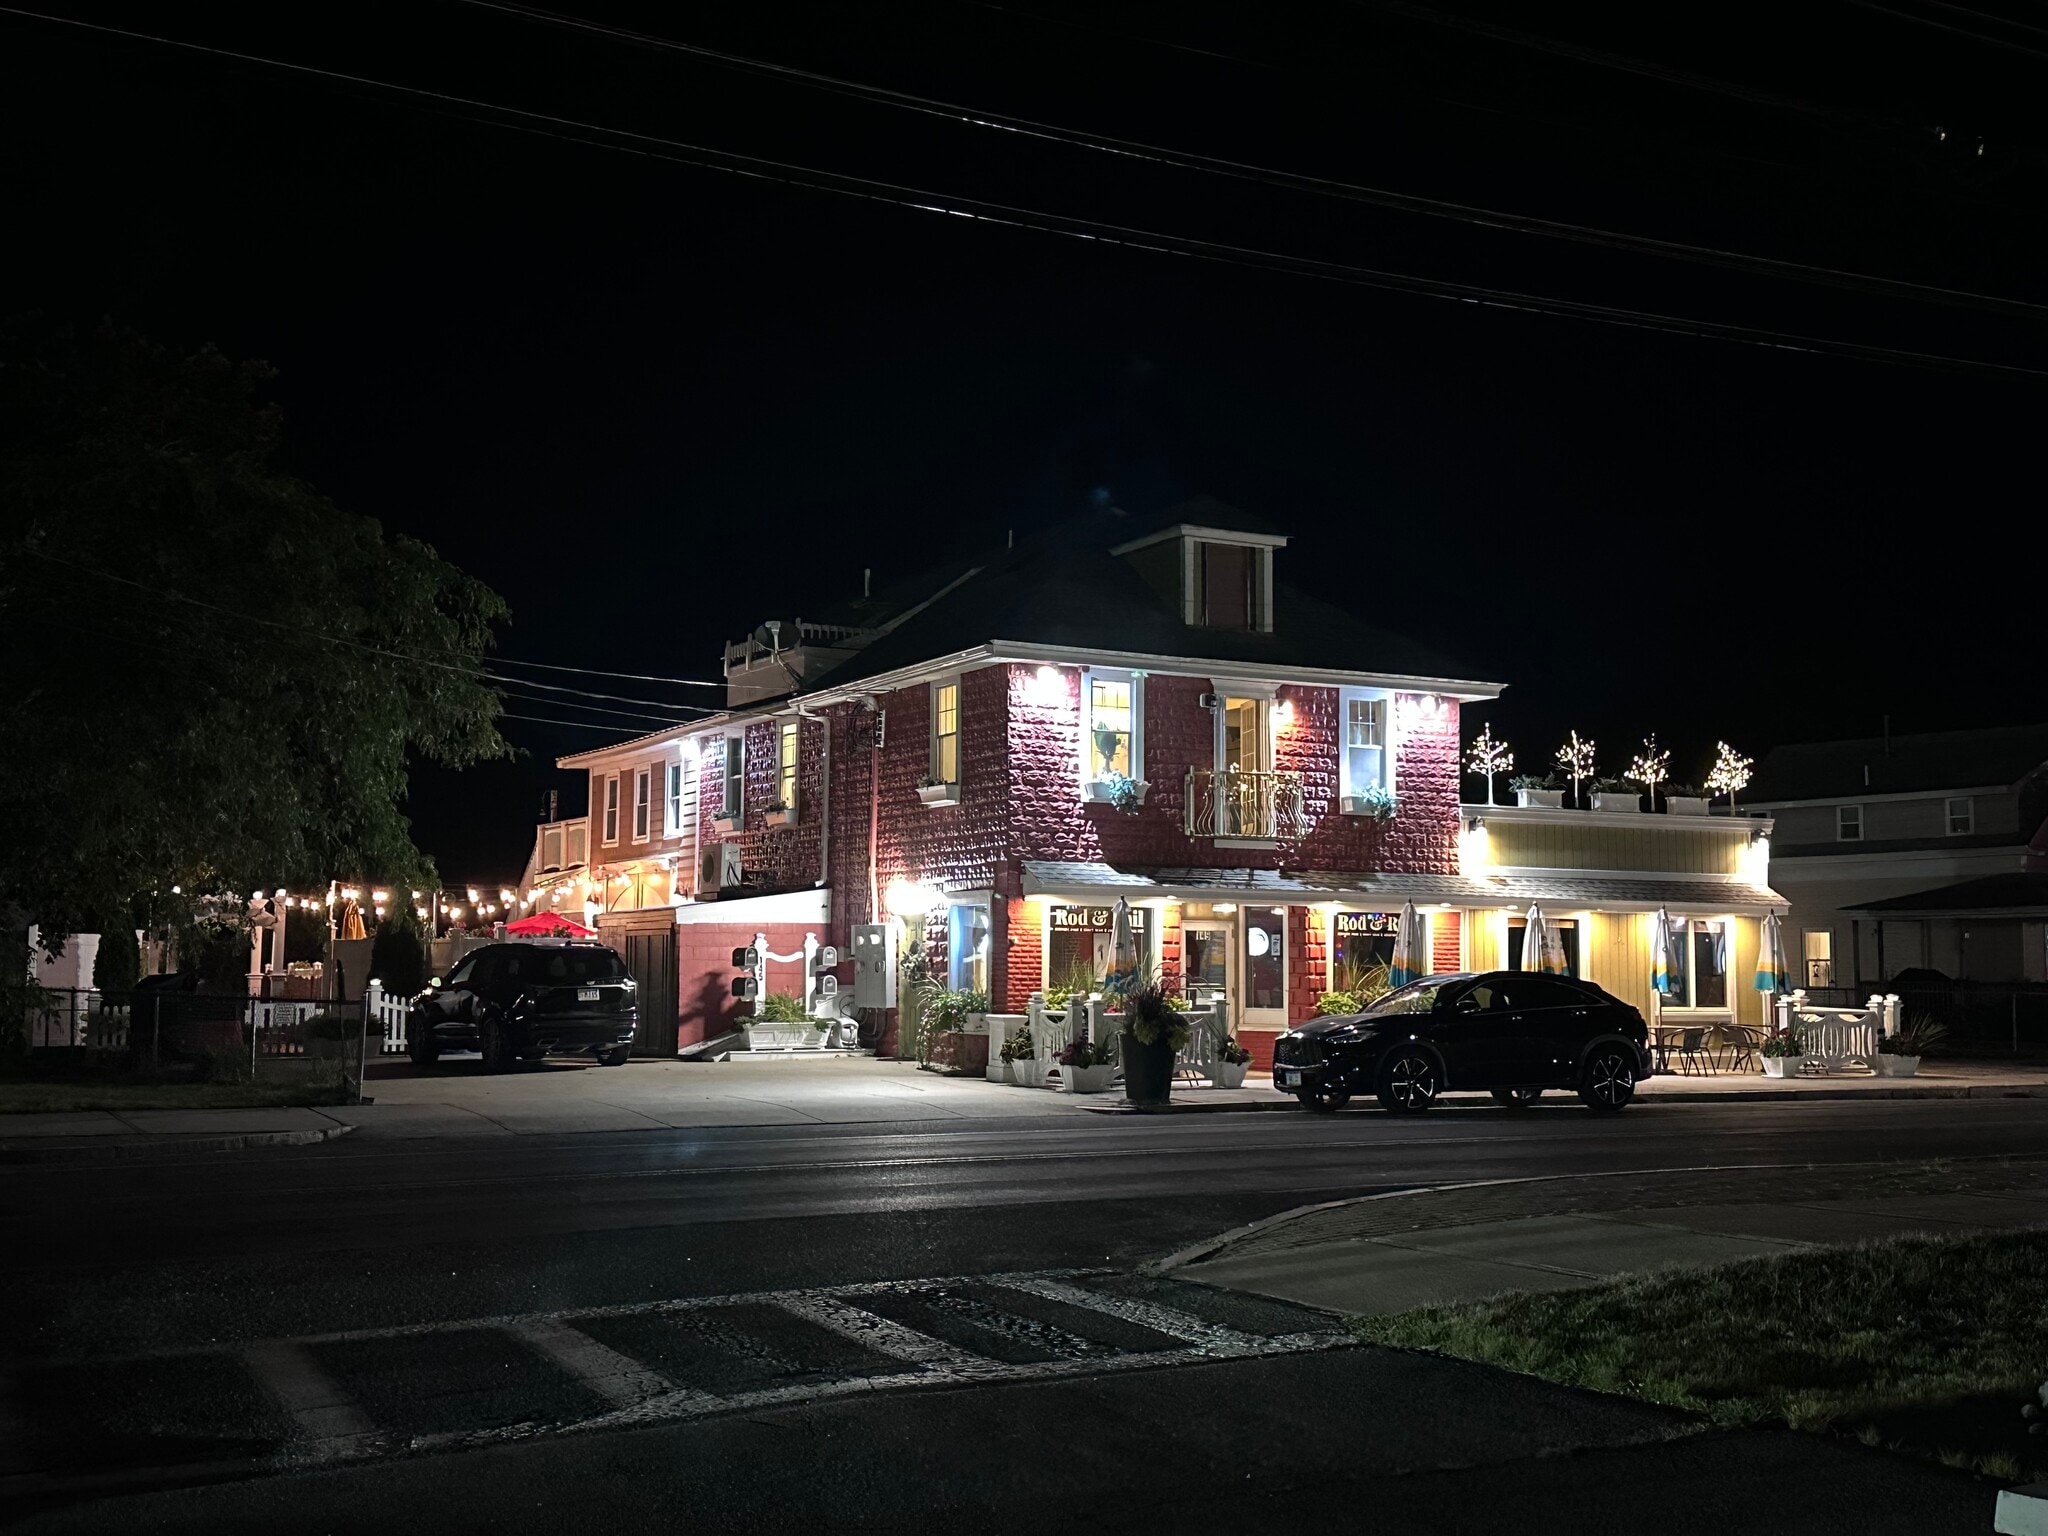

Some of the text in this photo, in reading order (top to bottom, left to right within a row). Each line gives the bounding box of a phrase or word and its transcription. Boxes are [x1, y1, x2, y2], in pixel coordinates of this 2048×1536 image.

[1055, 908, 1088, 926] Rod
[1091, 910, 1109, 926] &
[1337, 914, 1367, 931] Rod
